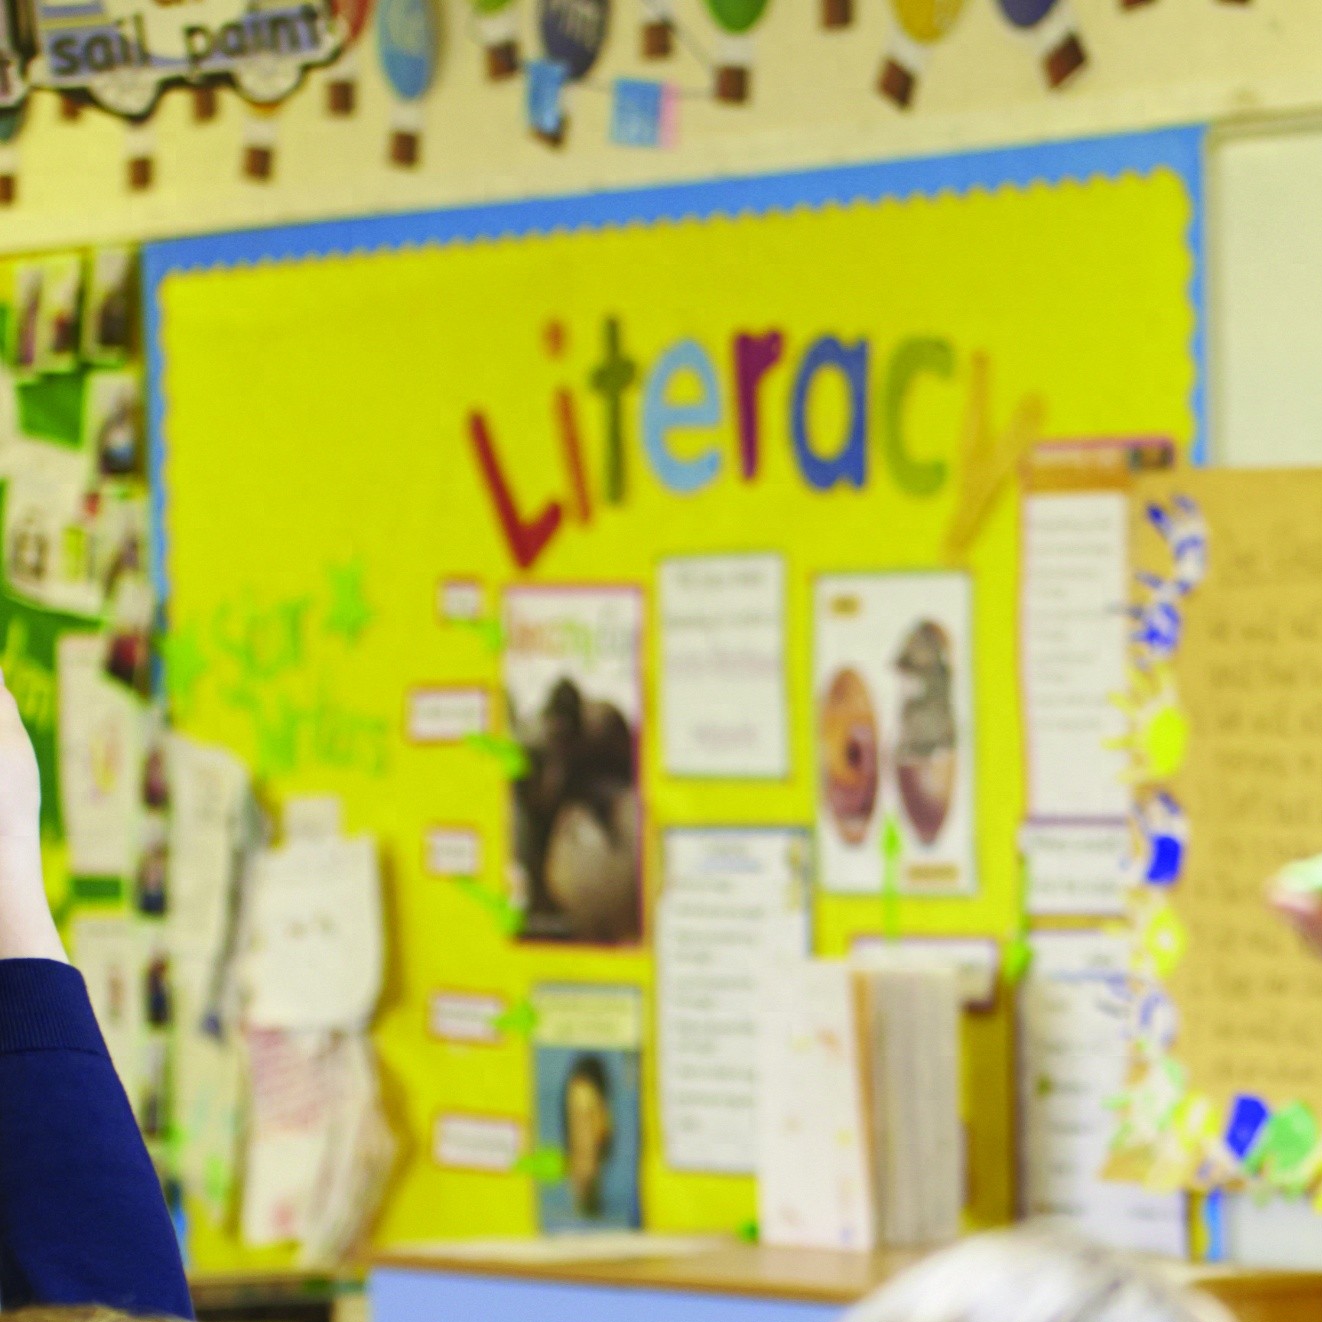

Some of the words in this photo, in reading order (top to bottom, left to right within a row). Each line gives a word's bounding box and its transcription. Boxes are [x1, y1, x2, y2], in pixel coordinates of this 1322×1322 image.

[51, 14, 149, 77] sail
[183, 5, 320, 80] paint
[466, 312, 1048, 572] Literacy
